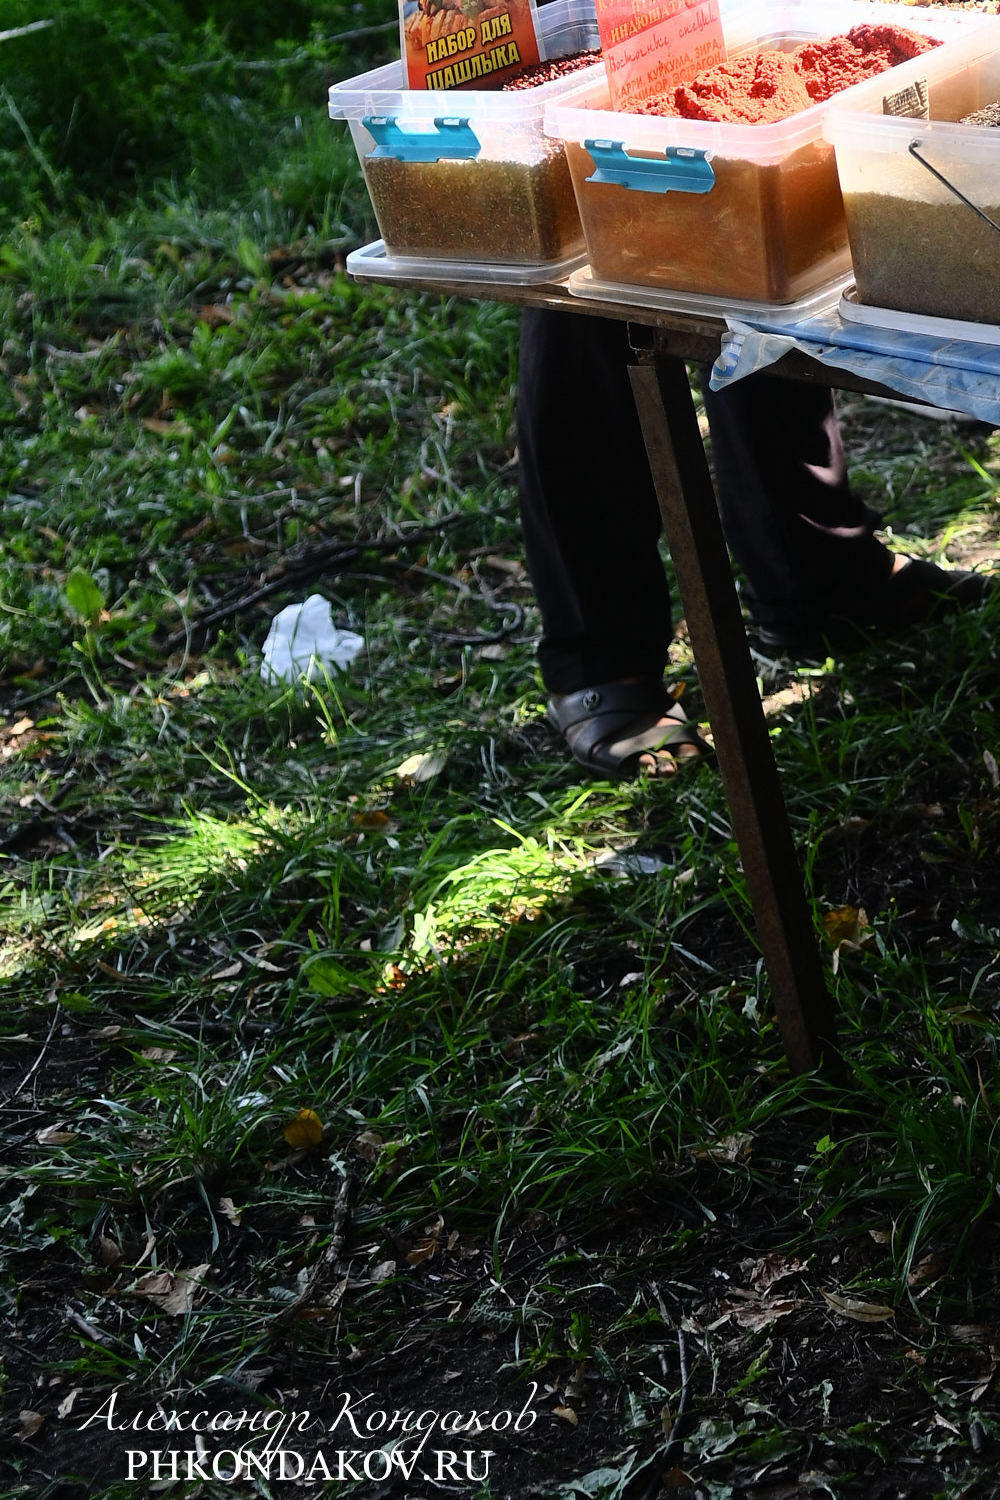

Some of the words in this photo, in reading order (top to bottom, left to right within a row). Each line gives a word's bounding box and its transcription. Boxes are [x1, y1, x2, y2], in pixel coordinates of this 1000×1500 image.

[426, 27, 476, 64] НАБОР
[480, 13, 512, 45] ДЛЯ
[695, 39, 722, 59] ЗИРА,
[426, 41, 521, 90] ШАШЛЫКА
